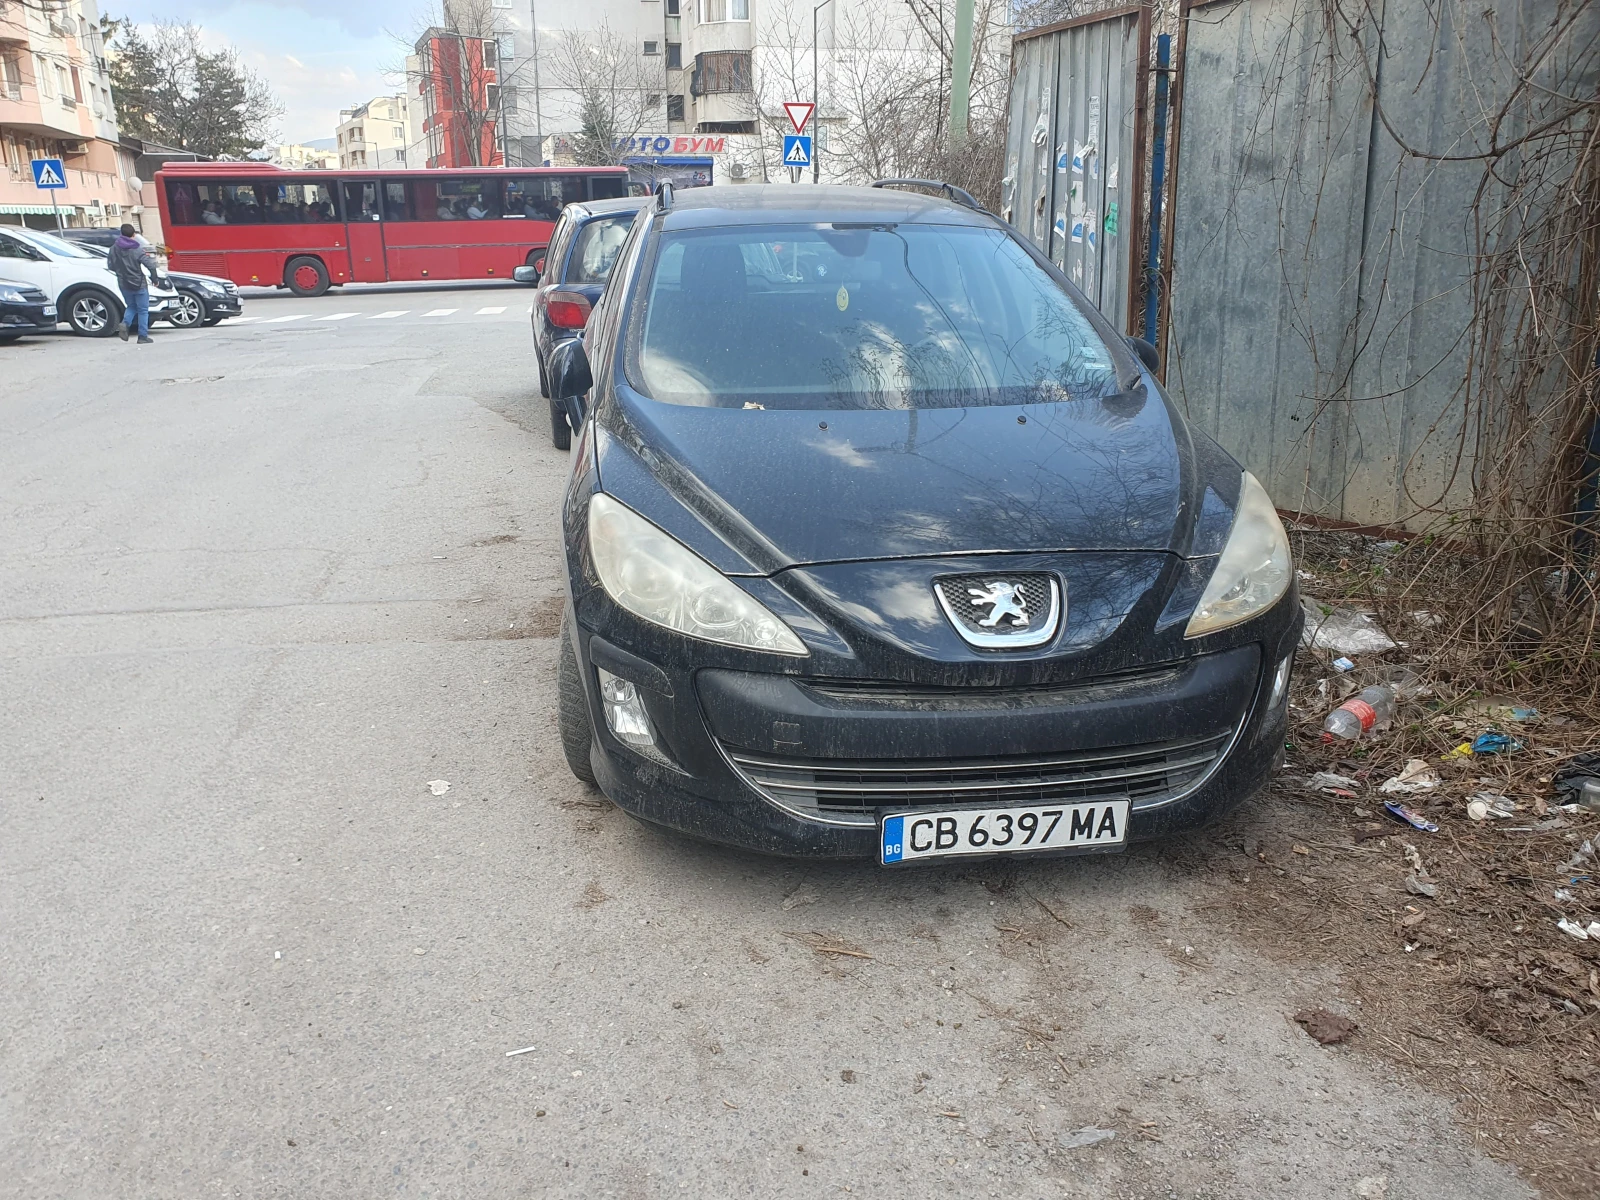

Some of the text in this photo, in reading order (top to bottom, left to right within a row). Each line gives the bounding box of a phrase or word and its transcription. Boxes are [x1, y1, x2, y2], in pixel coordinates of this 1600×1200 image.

[910, 806, 1117, 851] CB 6397 MA
[885, 844, 901, 856] BG
